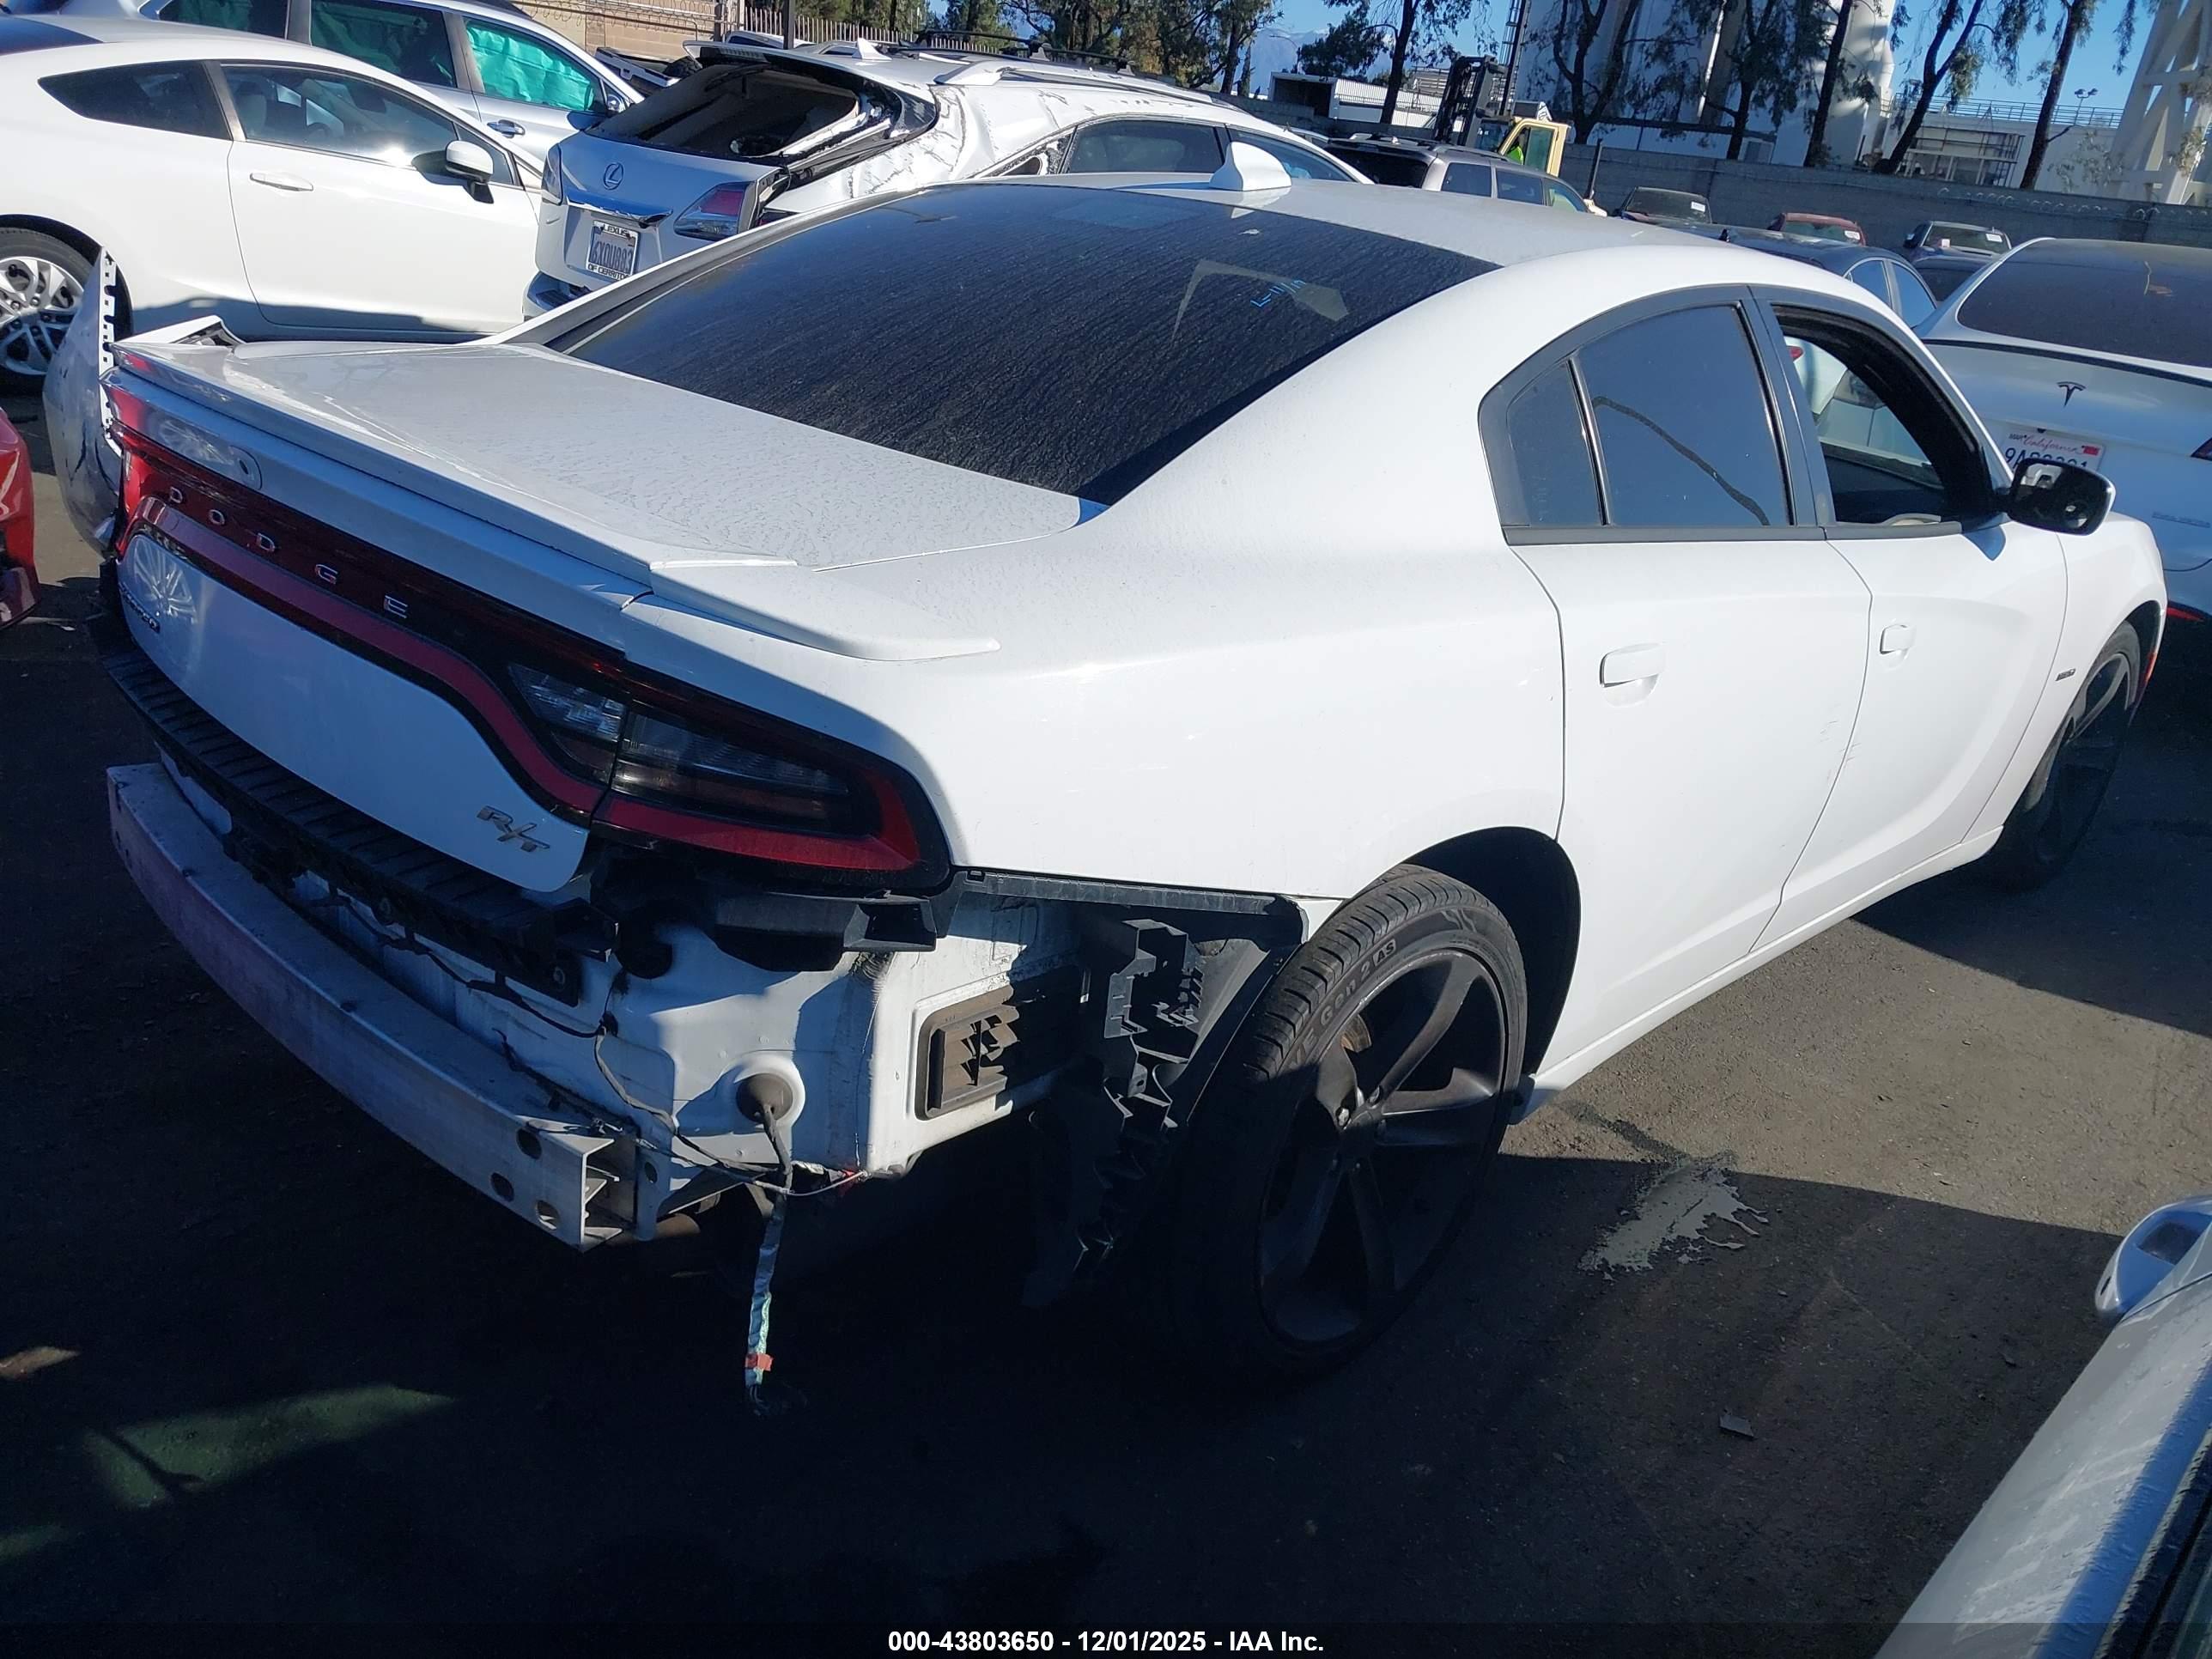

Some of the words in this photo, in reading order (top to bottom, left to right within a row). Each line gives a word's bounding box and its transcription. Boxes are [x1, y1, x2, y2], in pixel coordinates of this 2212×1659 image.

[603, 223, 629, 237] LEXUS
[587, 263, 598, 271] OF
[170, 486, 409, 620] DODGE
[1320, 979, 1357, 1026] Gen
[1360, 960, 1371, 982] 2
[1376, 941, 1395, 963] AS
